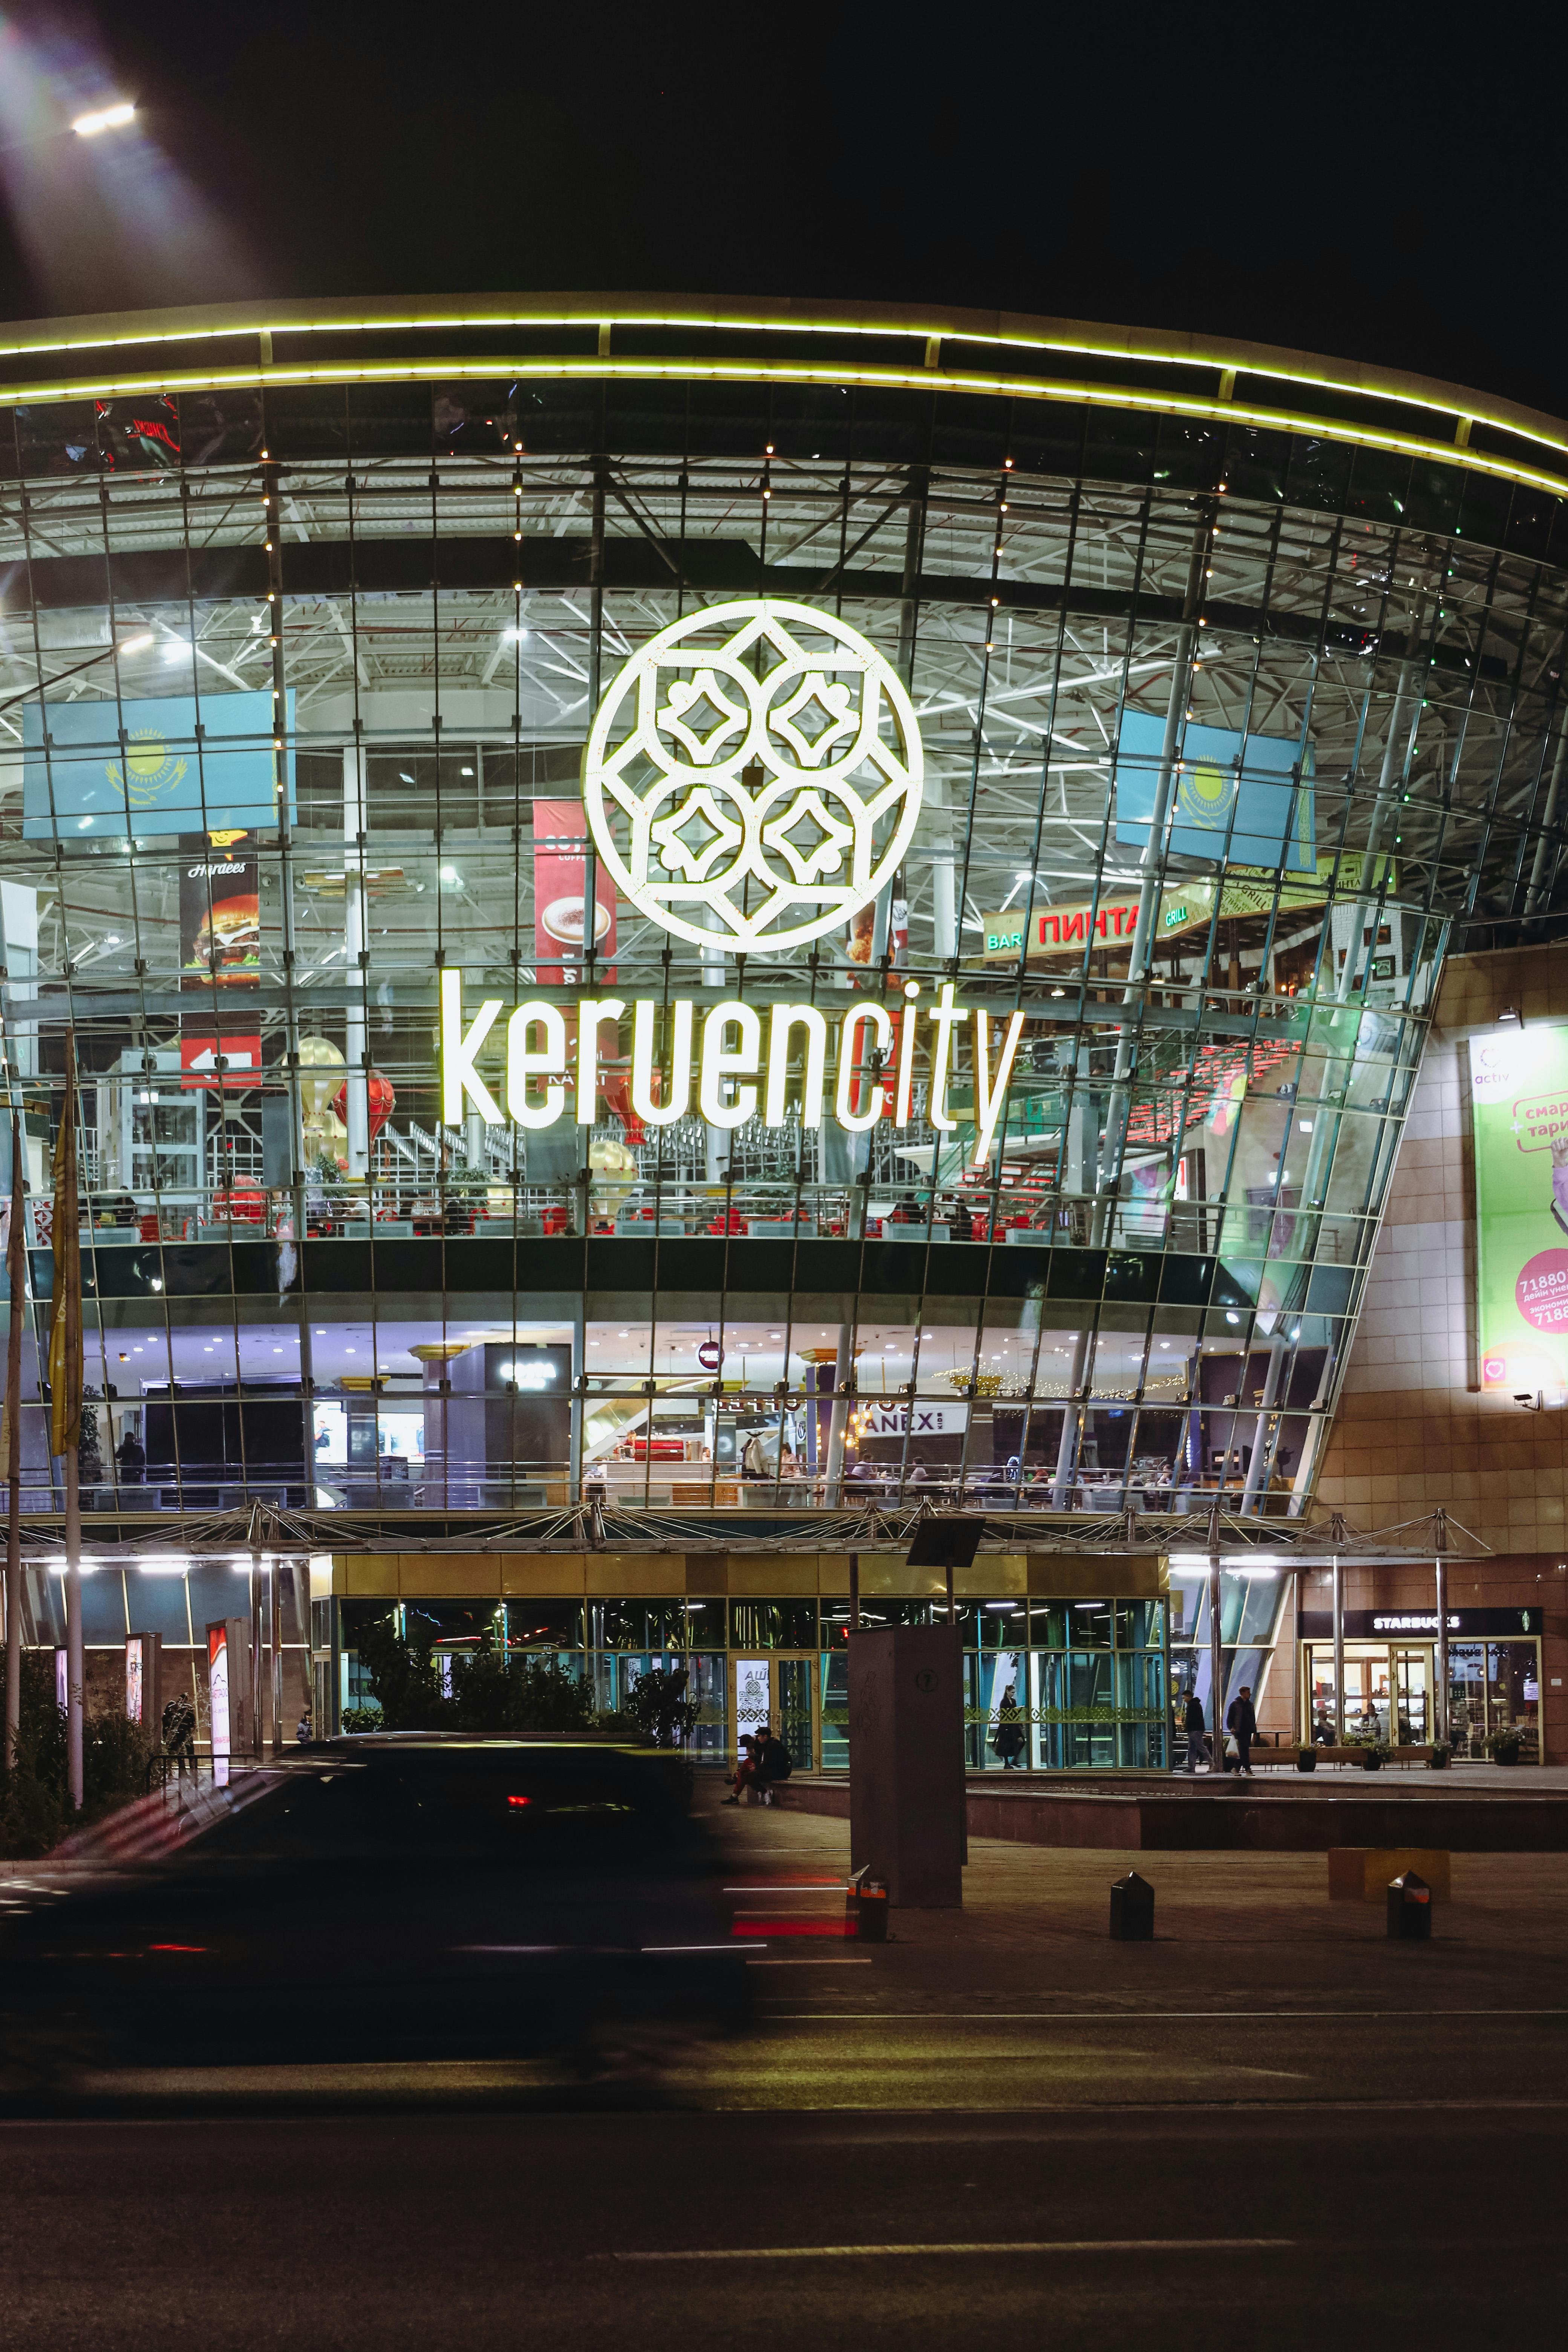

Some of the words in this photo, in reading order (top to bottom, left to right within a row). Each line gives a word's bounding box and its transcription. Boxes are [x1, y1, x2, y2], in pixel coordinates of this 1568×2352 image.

[1241, 885, 1266, 911] GRILL
[1039, 905, 1139, 944] ПИНТА
[1165, 906, 1187, 927] GRILL
[988, 932, 1022, 950] BAR
[1475, 1073, 1509, 1084] activ
[1520, 1269, 1568, 1293] 71880
[865, 1413, 933, 1432] ANEX
[1374, 1616, 1460, 1629] STARBUCS
